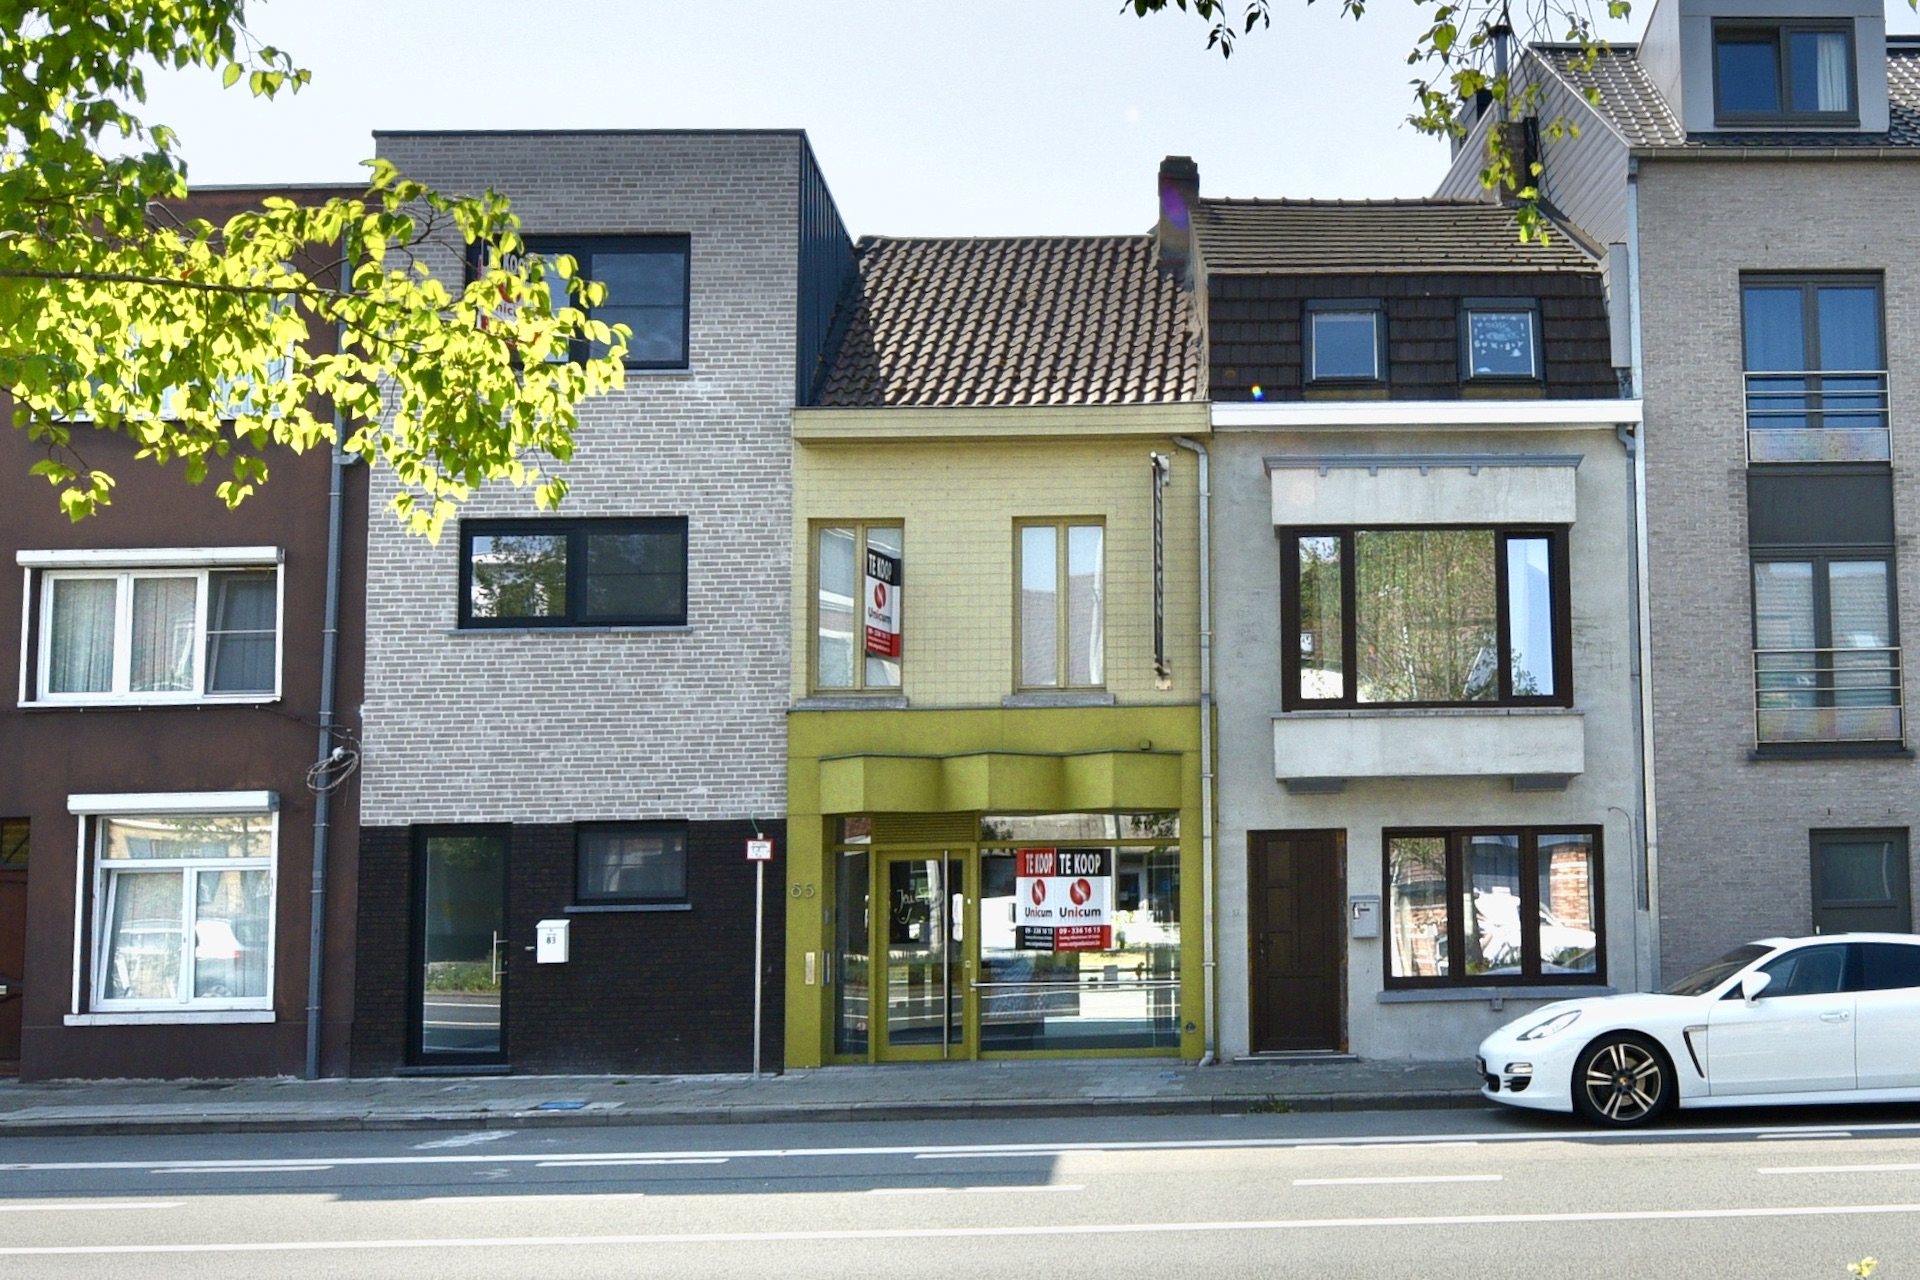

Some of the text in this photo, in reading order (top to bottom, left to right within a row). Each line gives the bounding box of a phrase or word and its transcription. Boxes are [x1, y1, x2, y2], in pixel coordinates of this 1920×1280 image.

[868, 553, 892, 582] TE KOOP
[868, 606, 891, 624] Unicum
[1026, 853, 1053, 874] TE KOOP
[1059, 853, 1101, 874] TE KOOP
[1025, 907, 1053, 918] Unicum
[1059, 906, 1101, 918] Unicum
[546, 936, 556, 945] 83
